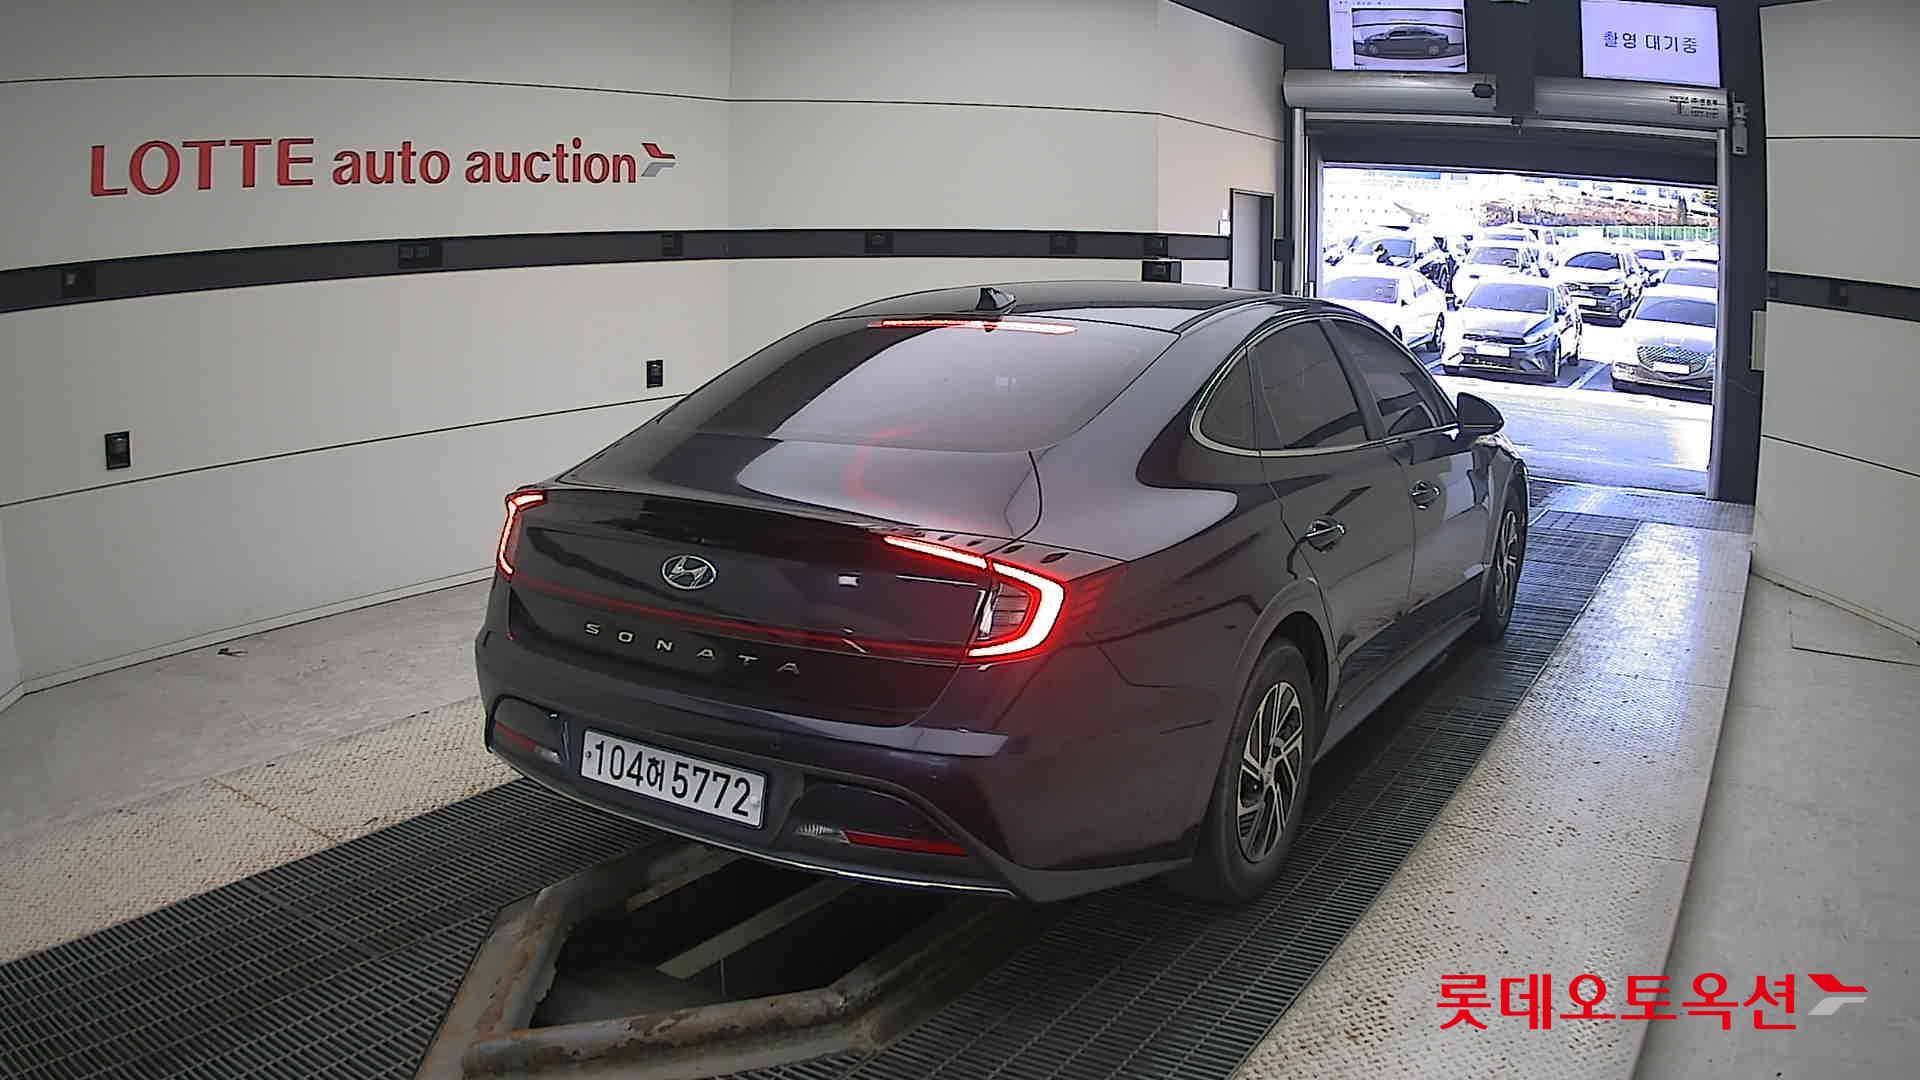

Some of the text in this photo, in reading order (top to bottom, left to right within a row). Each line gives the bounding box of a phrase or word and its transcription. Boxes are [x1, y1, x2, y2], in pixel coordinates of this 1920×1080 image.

[1645, 34, 1697, 54] 대기중
[90, 136, 638, 197] LOTTE auto auction
[585, 623, 800, 674] SONATA
